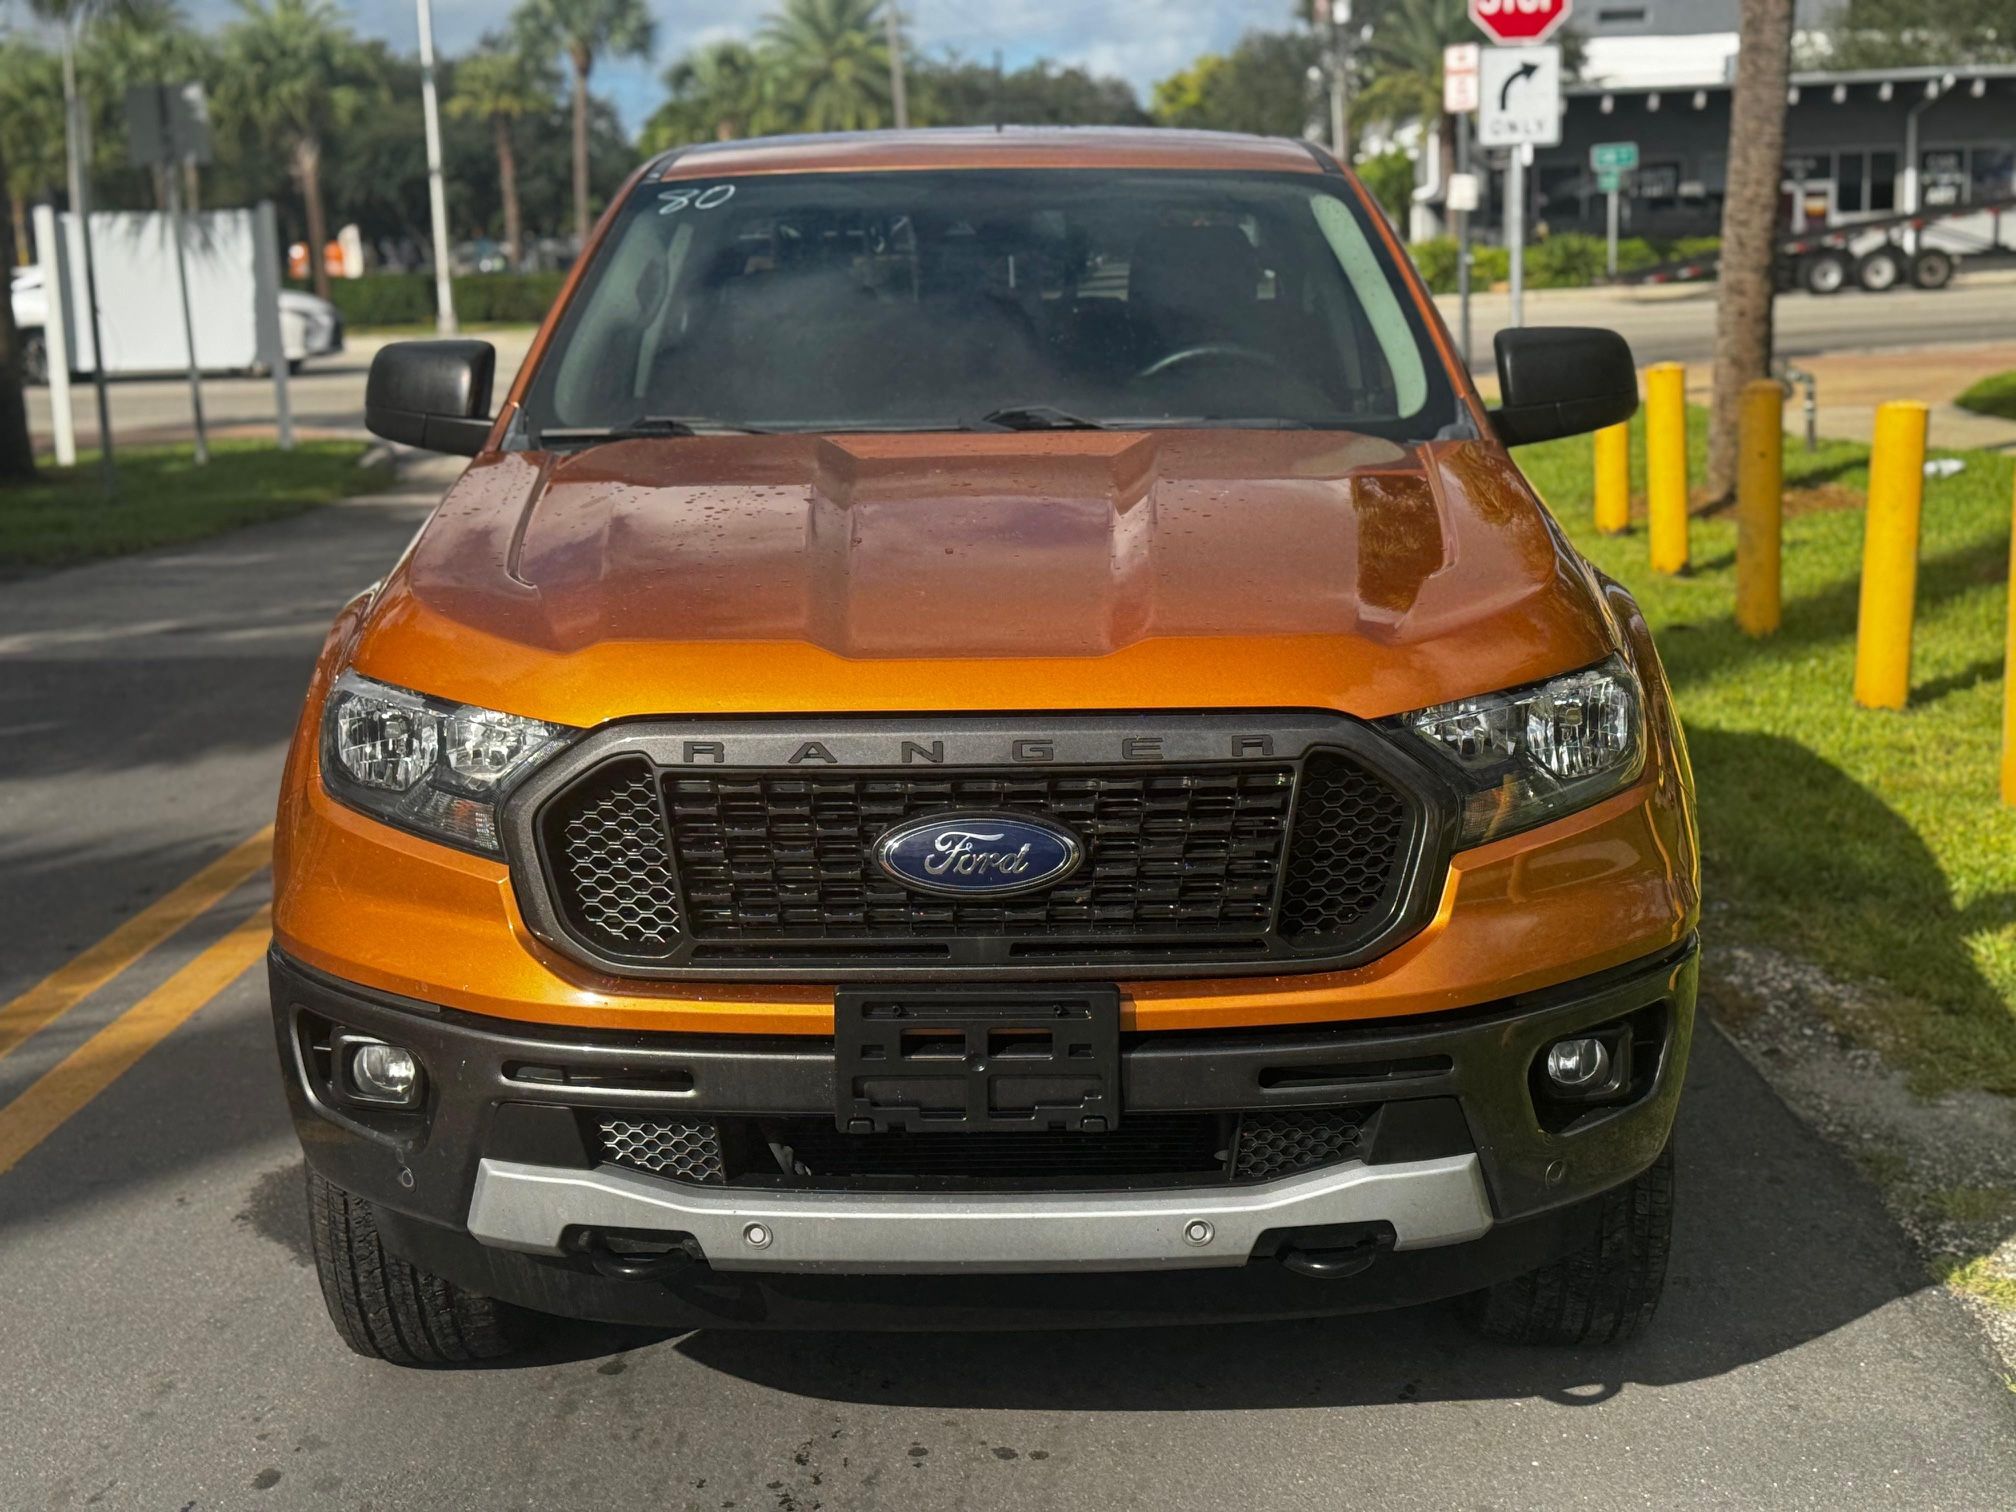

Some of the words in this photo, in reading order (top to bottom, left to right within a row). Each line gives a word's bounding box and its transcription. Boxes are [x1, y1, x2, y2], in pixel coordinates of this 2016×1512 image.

[657, 184, 736, 215] 80
[682, 734, 1275, 764] RANGER
[924, 831, 1031, 875] Ford
